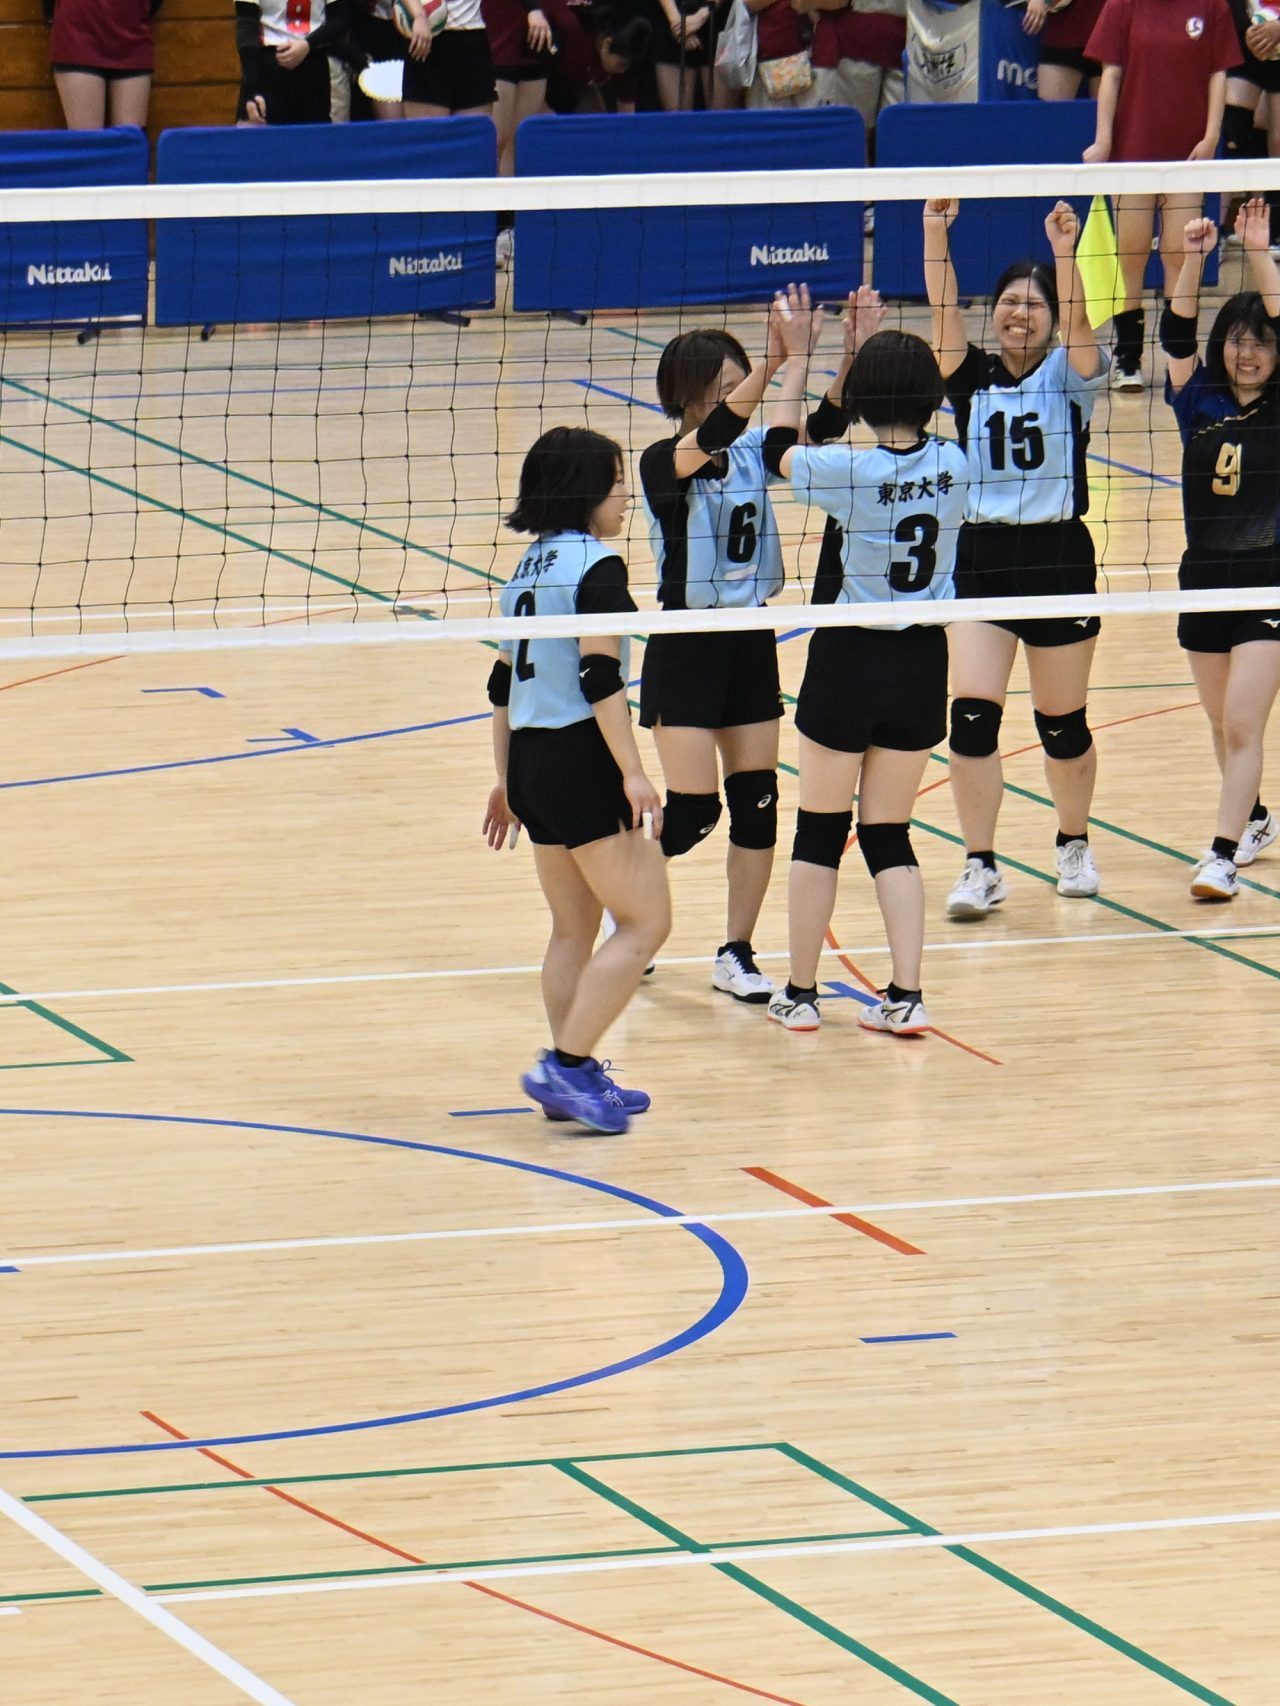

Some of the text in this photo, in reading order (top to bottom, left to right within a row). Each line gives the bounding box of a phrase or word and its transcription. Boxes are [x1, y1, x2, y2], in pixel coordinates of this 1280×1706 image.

[27, 261, 112, 286] Nittaku
[389, 252, 463, 277] Nittaku
[750, 242, 830, 266] Nittaku
[985, 411, 1045, 471] 15
[877, 471, 953, 506] 東京大学
[1211, 442, 1242, 496] 9
[727, 502, 757, 564] 6
[889, 514, 939, 593] 3
